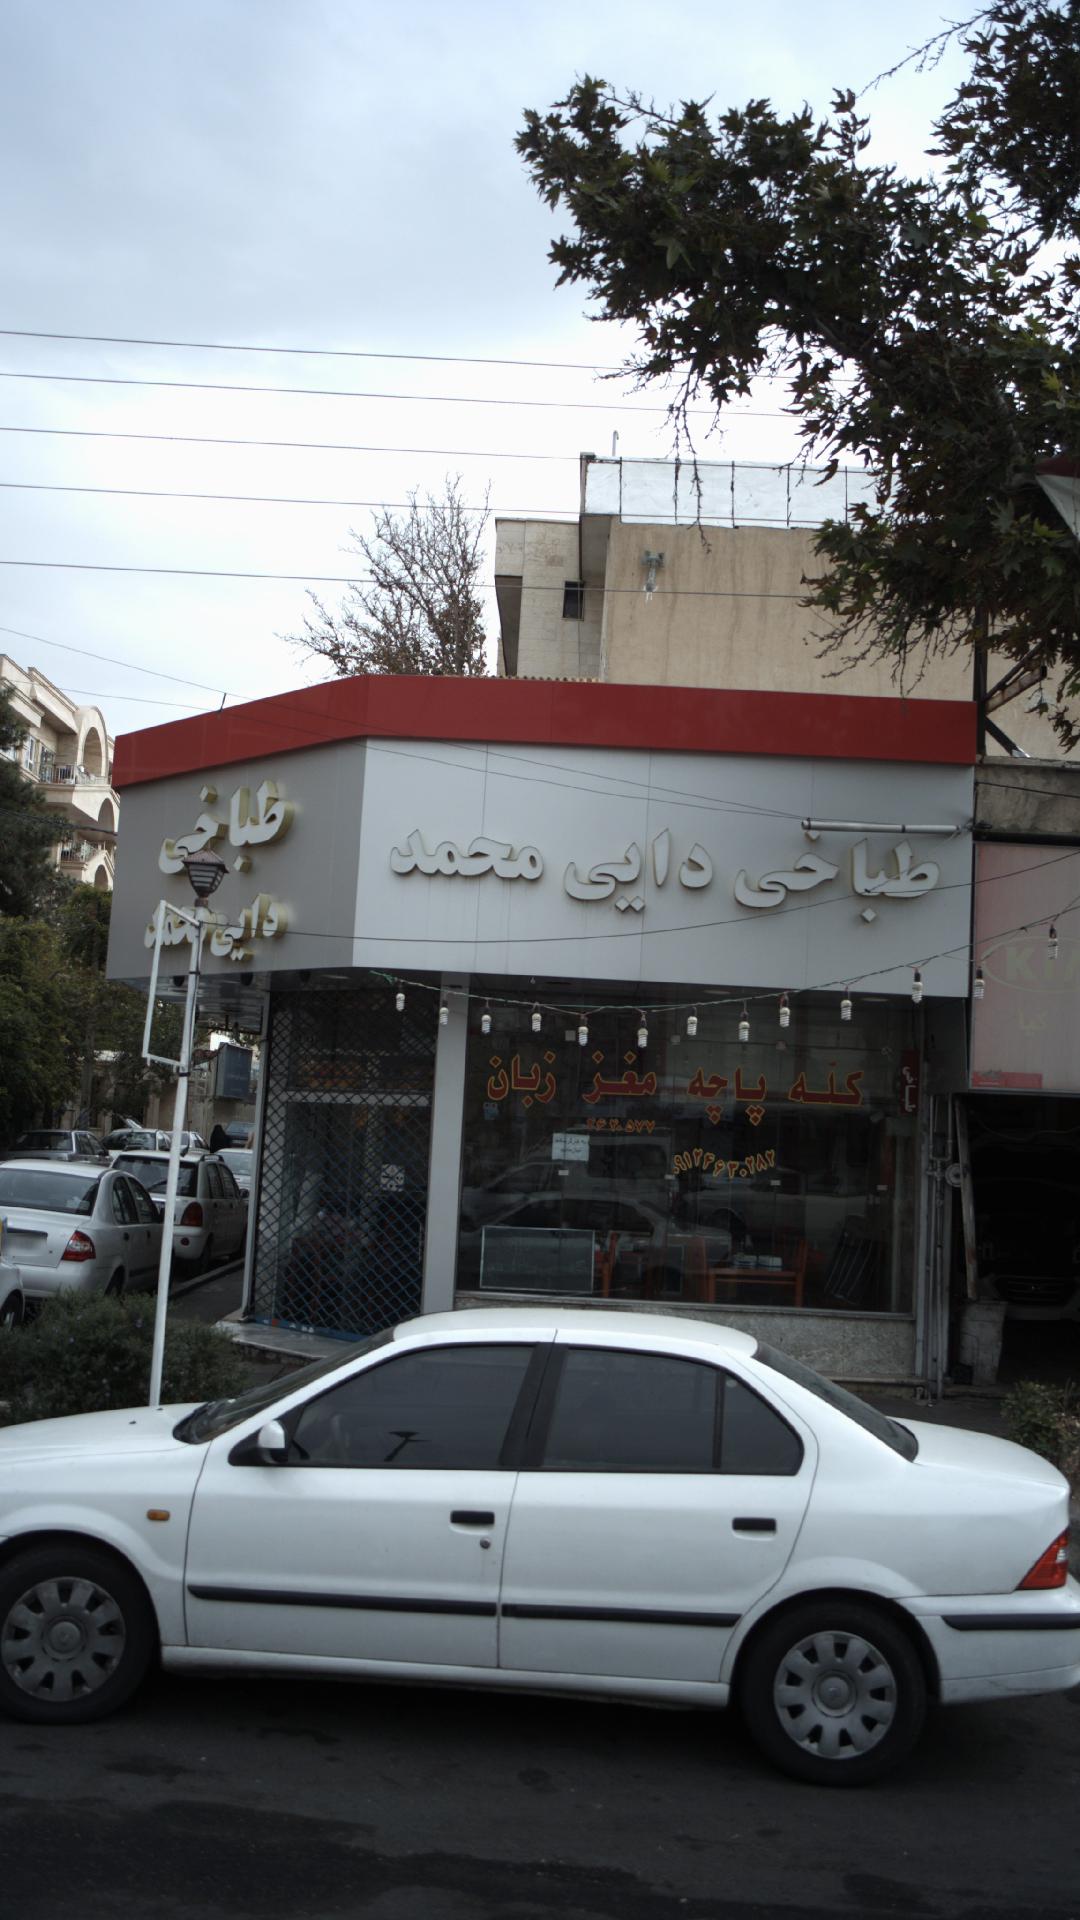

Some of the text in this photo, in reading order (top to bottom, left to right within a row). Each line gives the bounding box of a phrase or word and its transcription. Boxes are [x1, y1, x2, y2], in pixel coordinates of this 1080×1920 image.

[158, 779, 296, 875] طباخی
[390, 828, 941, 923] طباخی دایی محمد
[210, 893, 288, 961] دایی
[487, 1051, 556, 1108] زبان
[582, 1051, 657, 1104] مغز
[688, 1066, 768, 1126] پاچه
